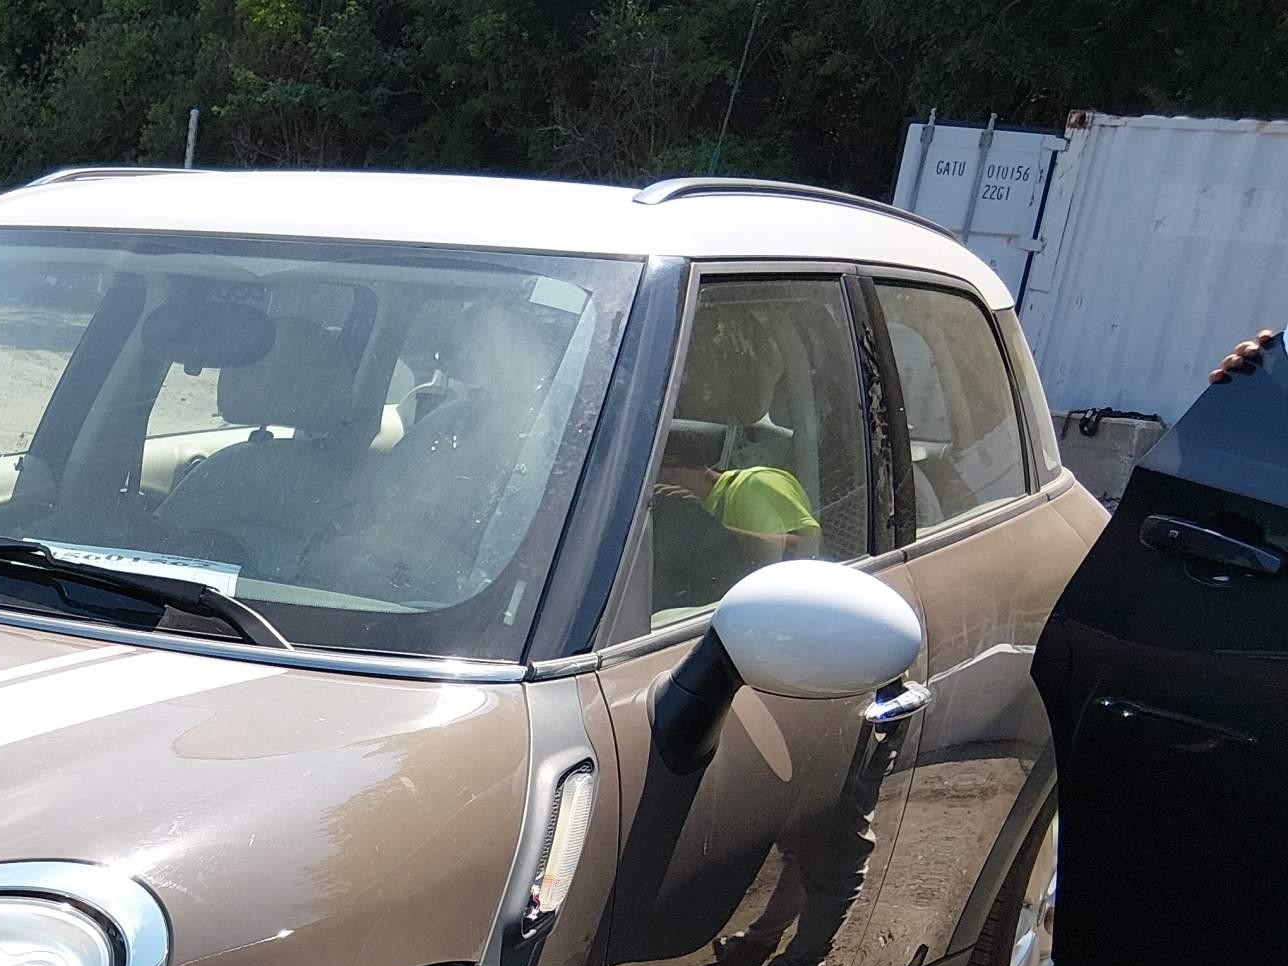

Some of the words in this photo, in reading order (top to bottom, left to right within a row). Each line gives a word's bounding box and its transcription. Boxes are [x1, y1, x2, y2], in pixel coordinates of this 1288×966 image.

[936, 160, 967, 177] GATU
[987, 164, 1031, 181] 010156
[982, 184, 1011, 201] 22G1
